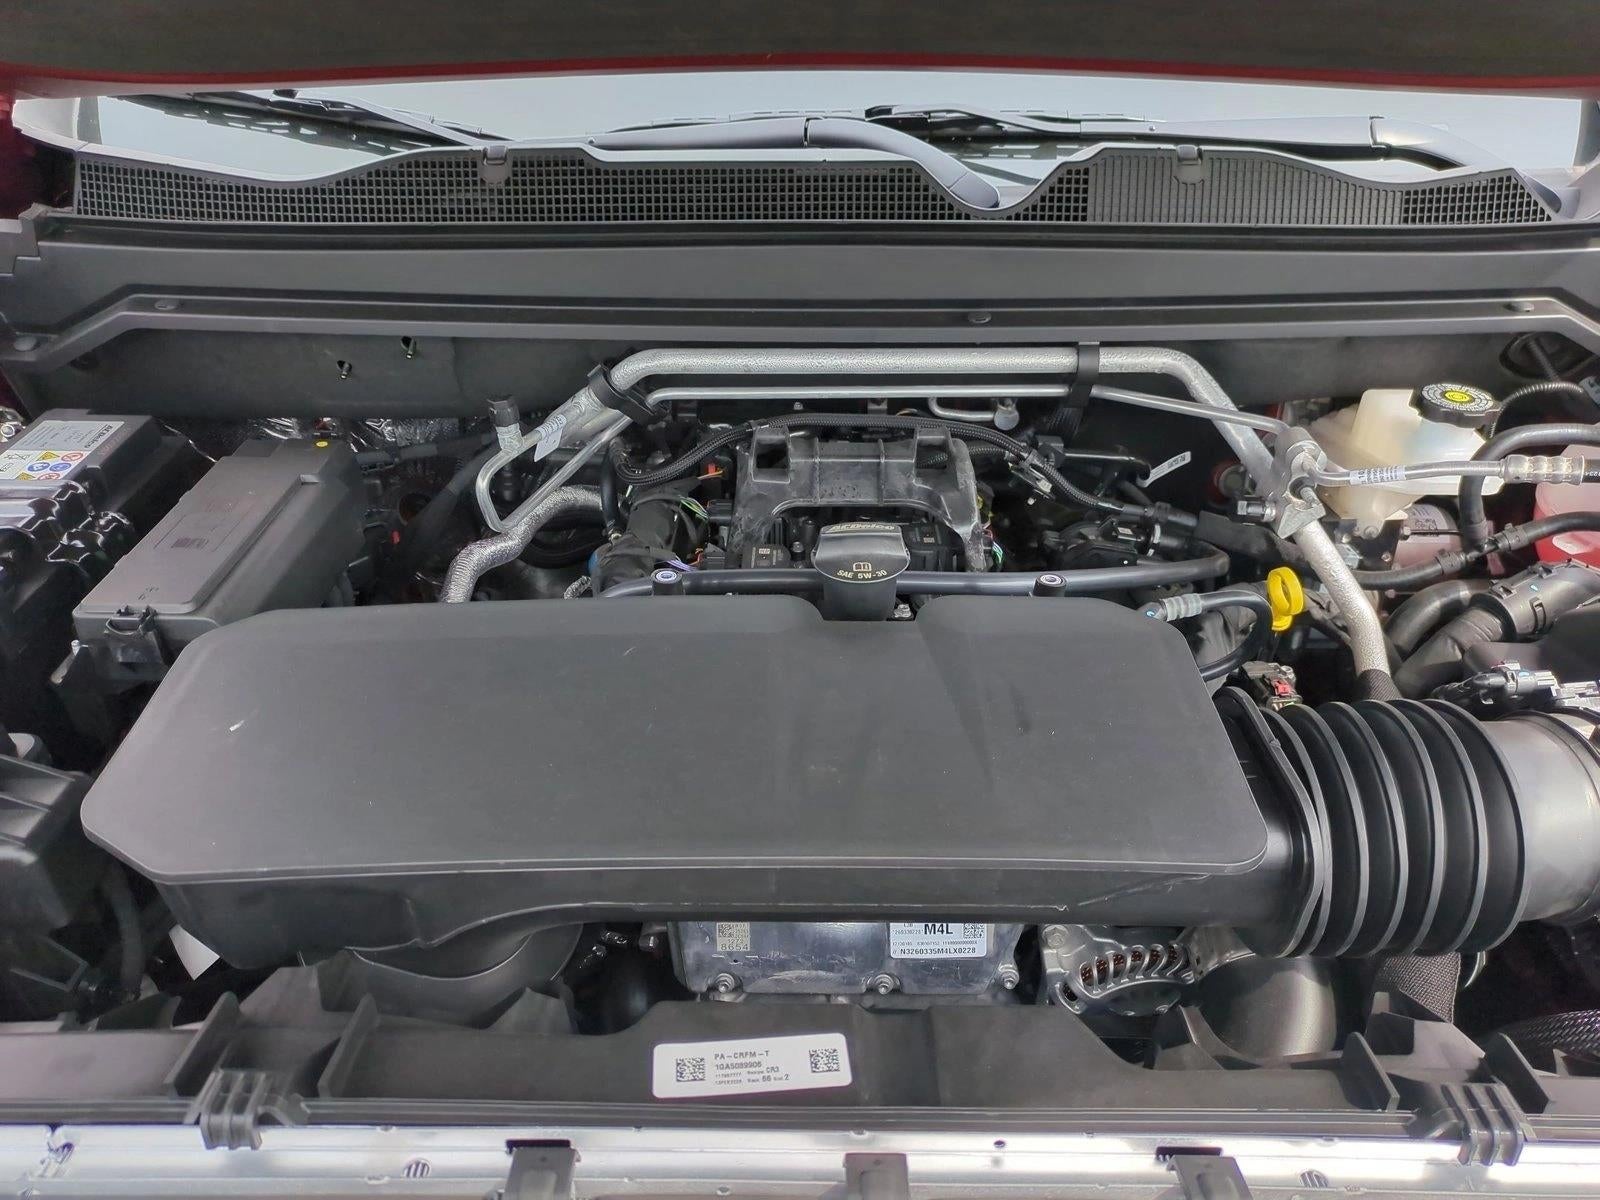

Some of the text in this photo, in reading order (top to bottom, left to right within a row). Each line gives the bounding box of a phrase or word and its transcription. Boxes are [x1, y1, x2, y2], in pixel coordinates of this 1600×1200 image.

[837, 569, 853, 578] SAE
[924, 923, 953, 935] M4L
[784, 1073, 790, 1081] 2
